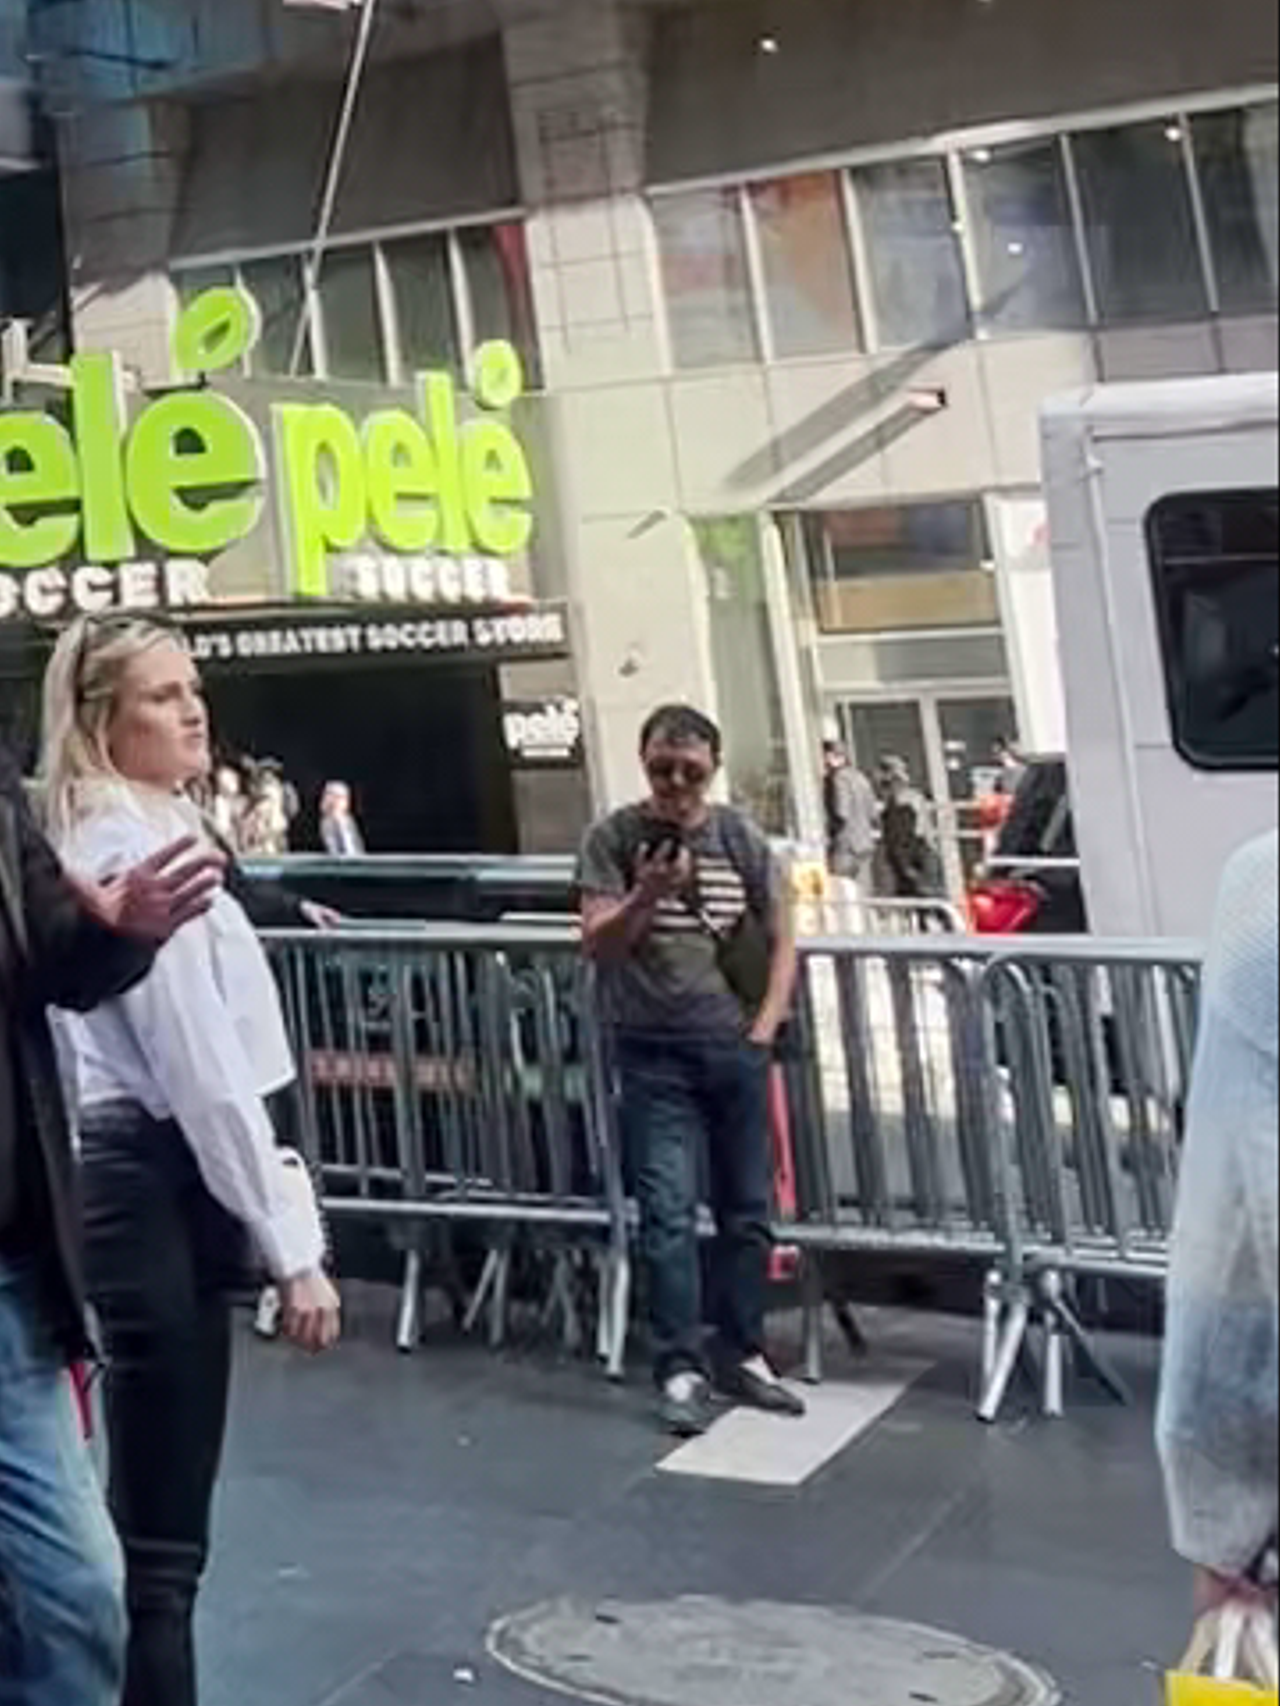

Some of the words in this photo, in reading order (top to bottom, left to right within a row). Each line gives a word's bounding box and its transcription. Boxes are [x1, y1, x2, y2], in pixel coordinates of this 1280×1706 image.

[270, 338, 534, 597] pelé
[348, 553, 512, 602] SOCCER
[238, 624, 362, 657] GREATEST
[366, 618, 469, 649] SOCCER
[473, 612, 564, 646] STORE
